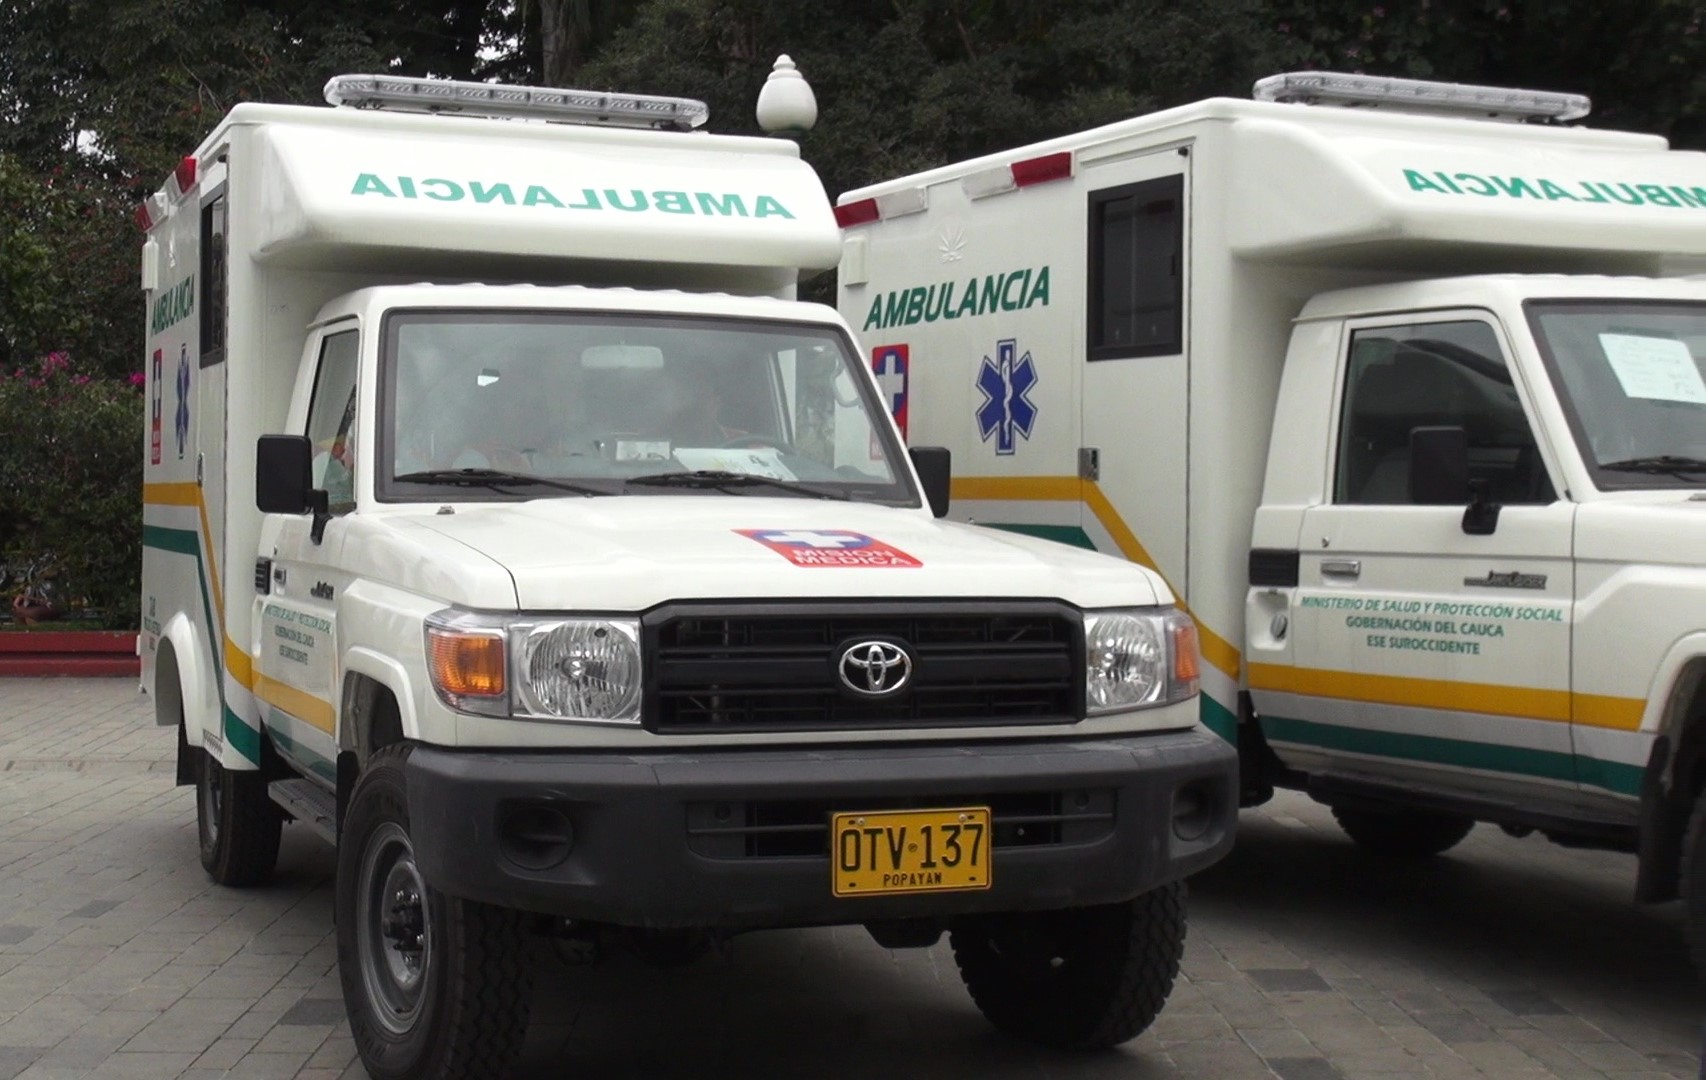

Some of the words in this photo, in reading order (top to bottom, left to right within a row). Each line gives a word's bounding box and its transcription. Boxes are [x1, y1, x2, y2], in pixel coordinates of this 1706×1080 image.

[863, 266, 1050, 332] AMBULANCIA
[1302, 596, 1363, 610] MINISTERIO
[1364, 599, 1380, 611] DE
[1382, 600, 1421, 613] SALUD
[1424, 602, 1432, 613] Y
[1433, 603, 1513, 618] PROTECCIÓN
[1515, 607, 1562, 622] SOCIAL
[1346, 615, 1432, 632] GOBERNACIÓN
[1434, 621, 1457, 634] DEL
[1460, 622, 1504, 637] CAUCA
[1367, 635, 1386, 648] ESE
[1389, 637, 1480, 654] SUROCCIDENTE
[840, 826, 906, 872] OTV
[920, 823, 984, 869] 137
[883, 872, 942, 887] POPAYAN
